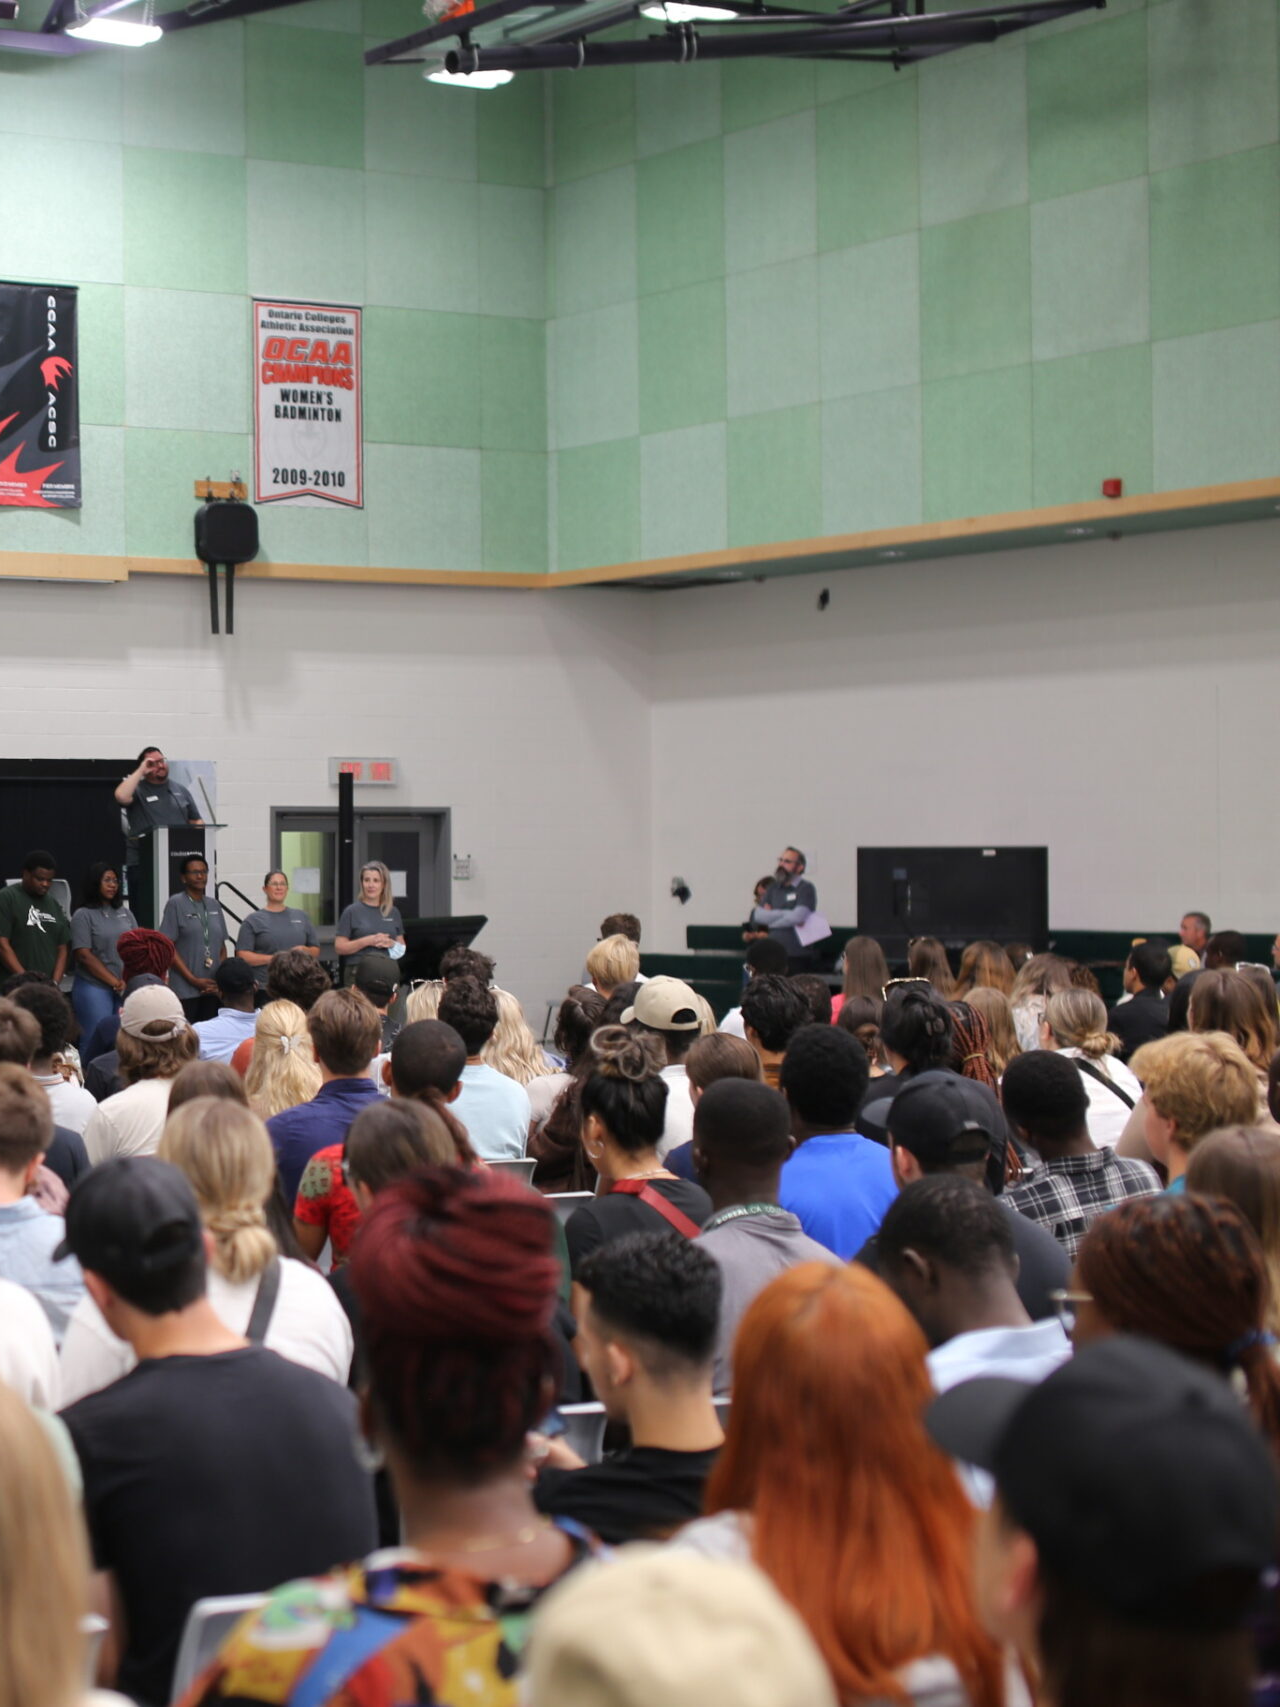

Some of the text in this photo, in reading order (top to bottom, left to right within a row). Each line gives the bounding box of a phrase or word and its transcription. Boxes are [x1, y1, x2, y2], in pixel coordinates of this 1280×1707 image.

[47, 295, 57, 351] CCAA
[268, 309, 347, 324] Ontario Colleges
[261, 320, 354, 336] Athletic Association
[262, 336, 353, 366] OCAA
[261, 361, 354, 391] CHAMPIONS
[280, 388, 334, 406] WOMEN'S
[274, 404, 342, 422] BADMINTON
[272, 468, 345, 487] 2009-2010
